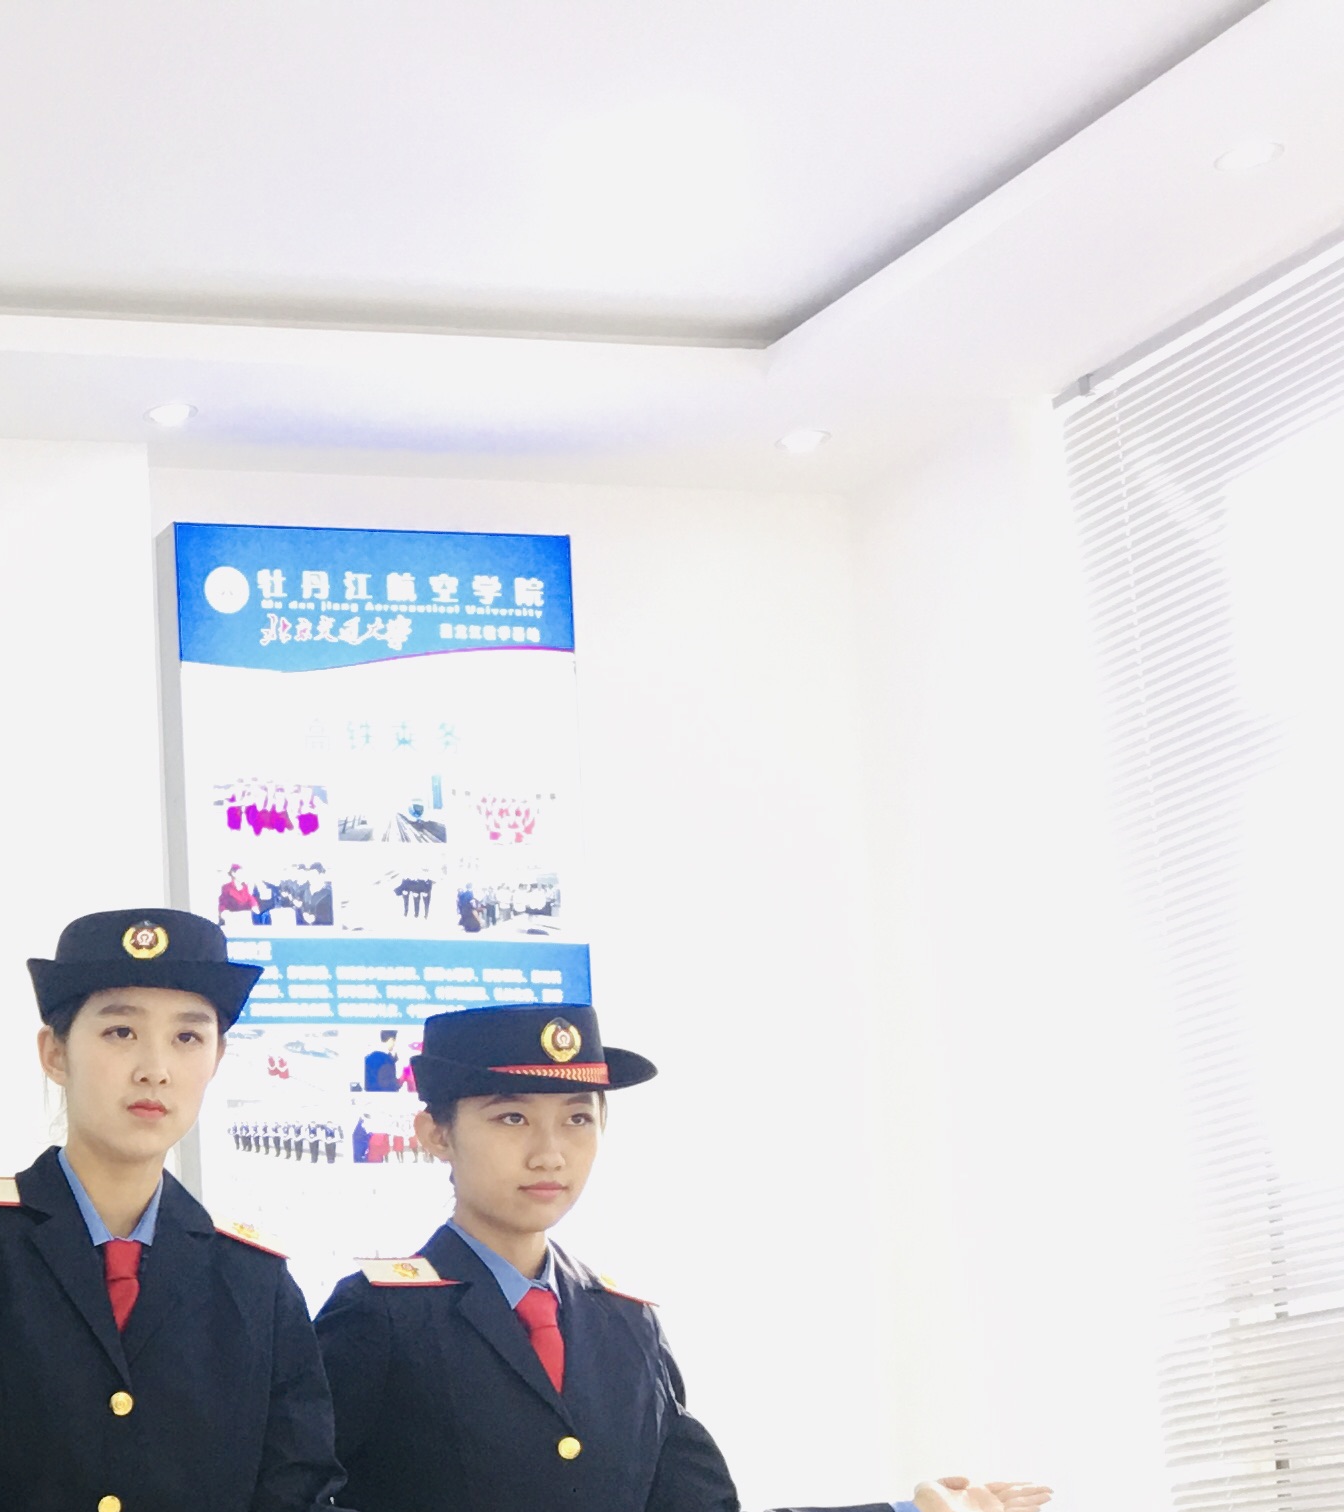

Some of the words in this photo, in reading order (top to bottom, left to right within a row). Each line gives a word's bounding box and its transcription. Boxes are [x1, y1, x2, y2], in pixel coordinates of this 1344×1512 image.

[256, 568, 545, 607] 牡丹江航空学院
